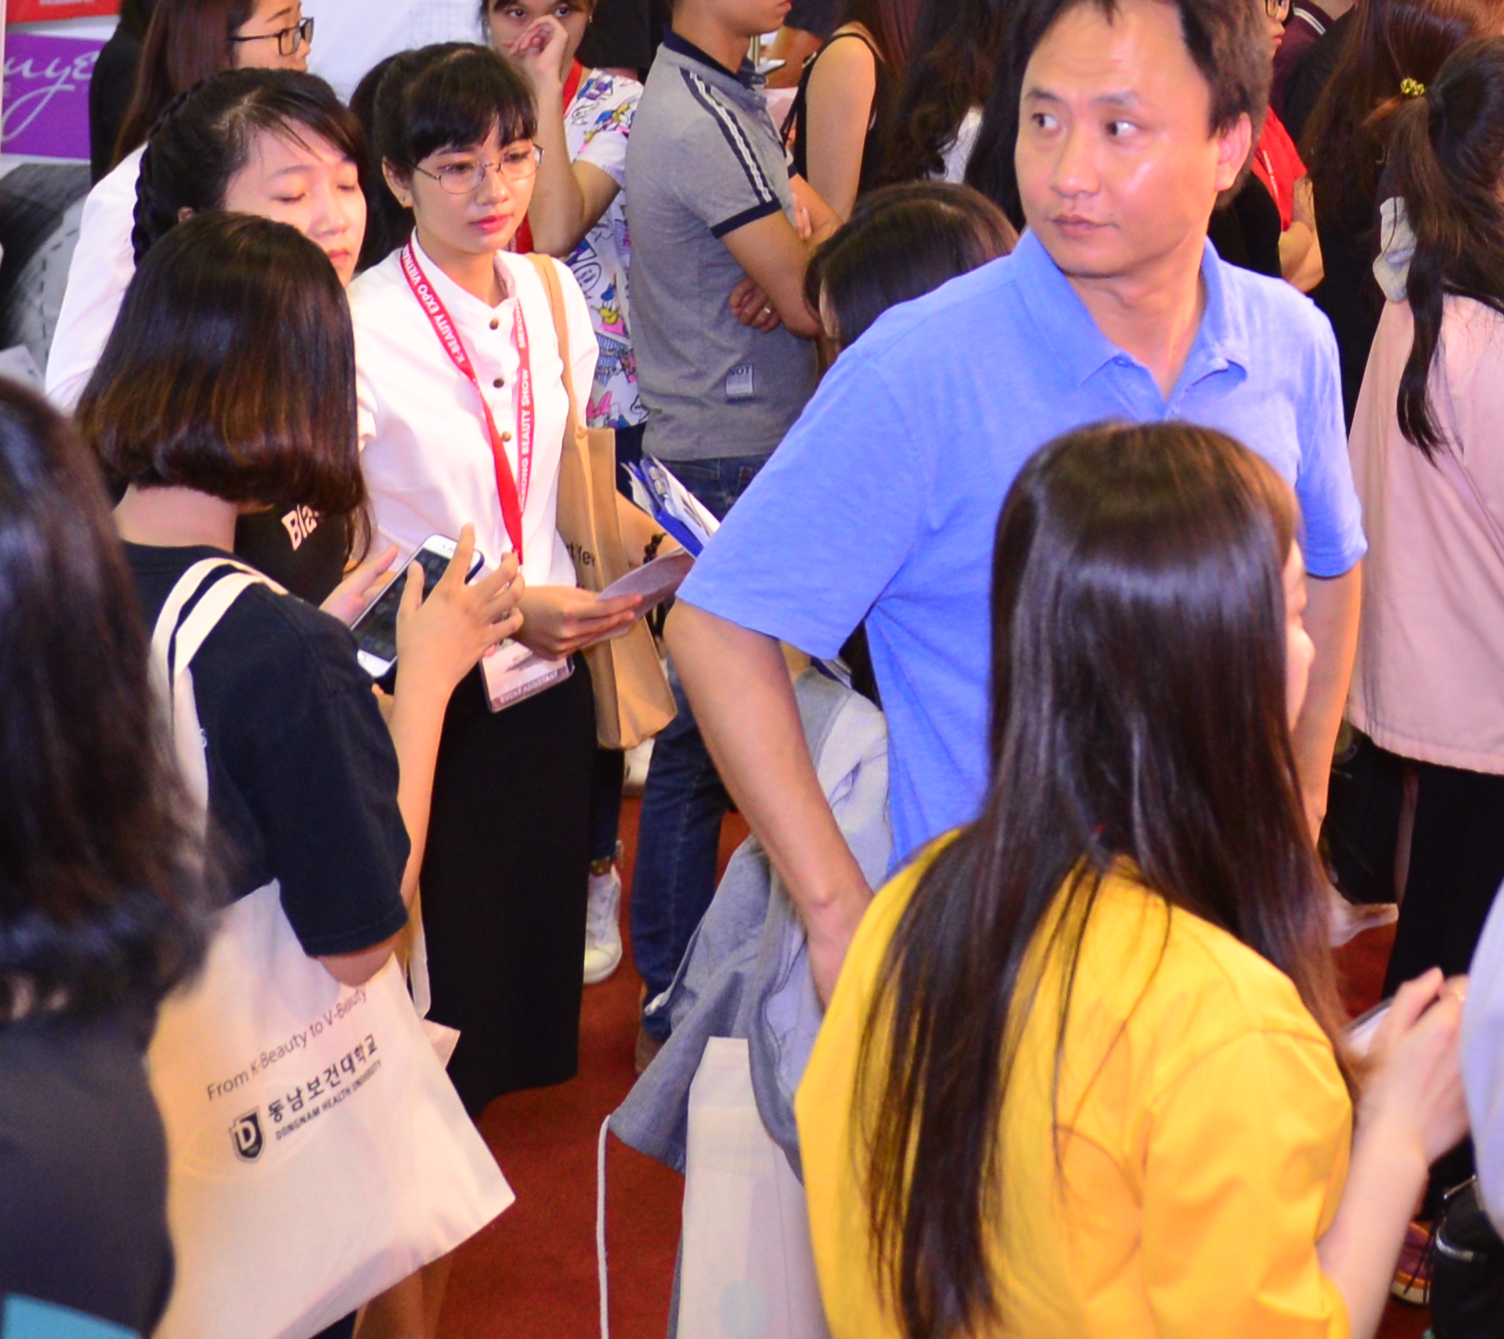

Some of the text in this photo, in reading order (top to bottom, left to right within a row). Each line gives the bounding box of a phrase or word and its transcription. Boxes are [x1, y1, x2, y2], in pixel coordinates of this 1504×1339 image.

[418, 284, 465, 364] K-BEAUTY EXPO
[521, 368, 531, 454] BEAUTY SHOW
[206, 989, 367, 1101] From K-Beauty to V-Beauty
[267, 1033, 378, 1123] 동남보건대학교
[276, 1107, 321, 1140] DONGNAM
